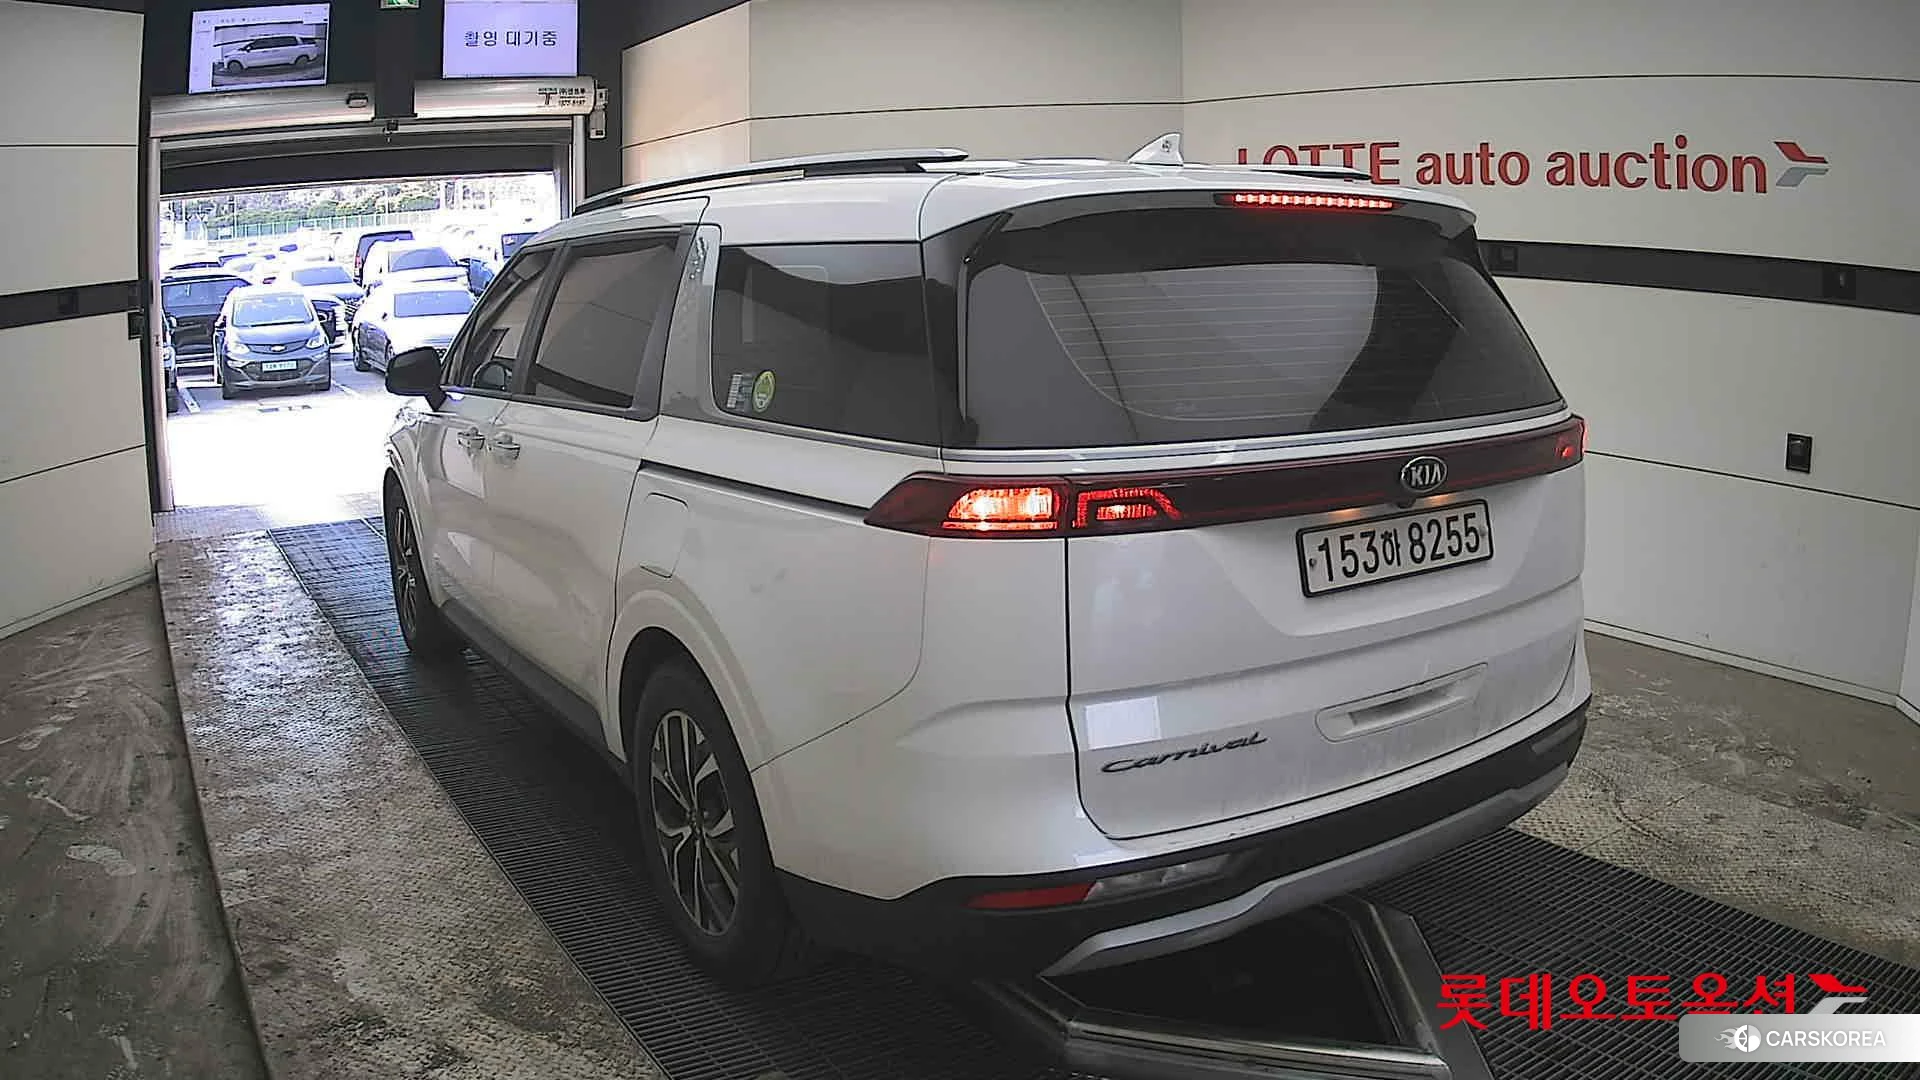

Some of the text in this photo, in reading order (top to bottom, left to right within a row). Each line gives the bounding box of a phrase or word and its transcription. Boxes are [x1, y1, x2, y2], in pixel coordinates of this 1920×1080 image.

[506, 30, 558, 47] 대기중
[1415, 142, 1531, 186] auto
[1545, 134, 1768, 194] auction
[1410, 463, 1442, 487] KIA
[1318, 512, 1480, 583] 153하 8255
[1101, 731, 1268, 773] Carnival
